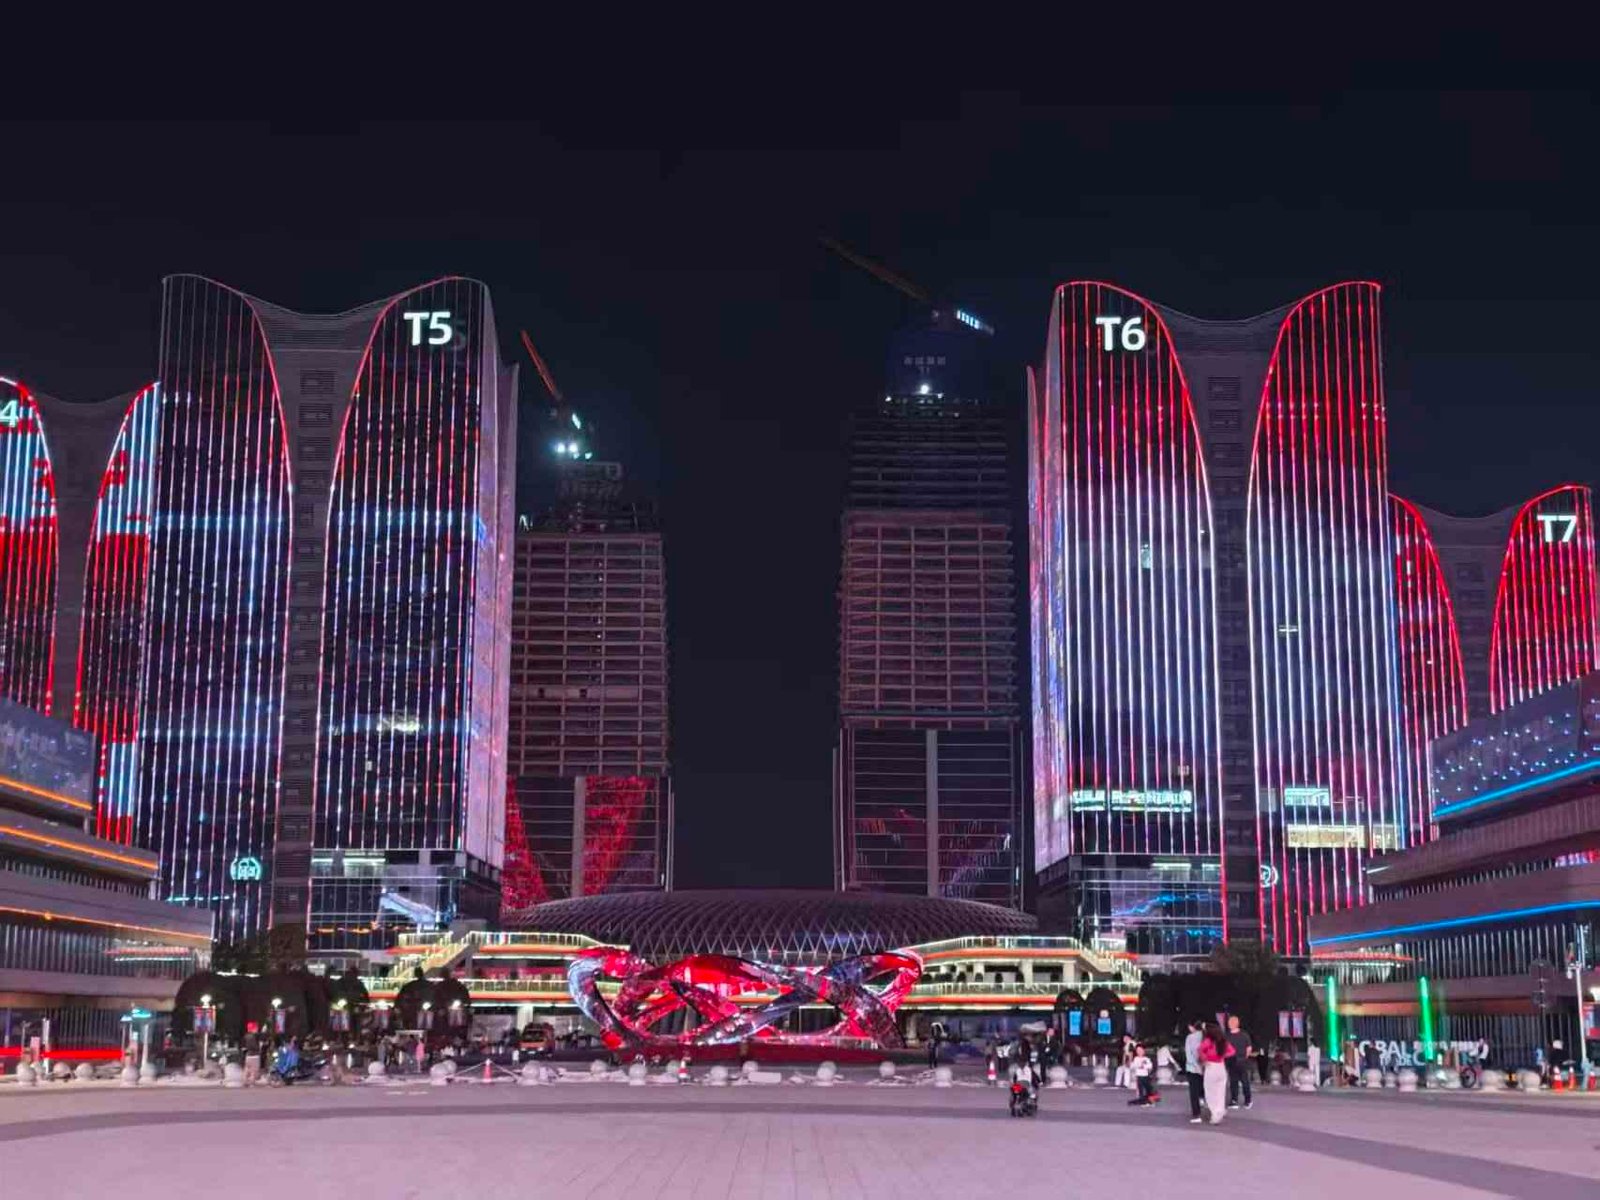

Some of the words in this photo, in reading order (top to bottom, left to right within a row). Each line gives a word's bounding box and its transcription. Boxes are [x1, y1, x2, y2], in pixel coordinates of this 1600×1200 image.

[403, 311, 453, 346] T5
[1095, 316, 1146, 351] T6
[1536, 514, 1577, 543] T7
